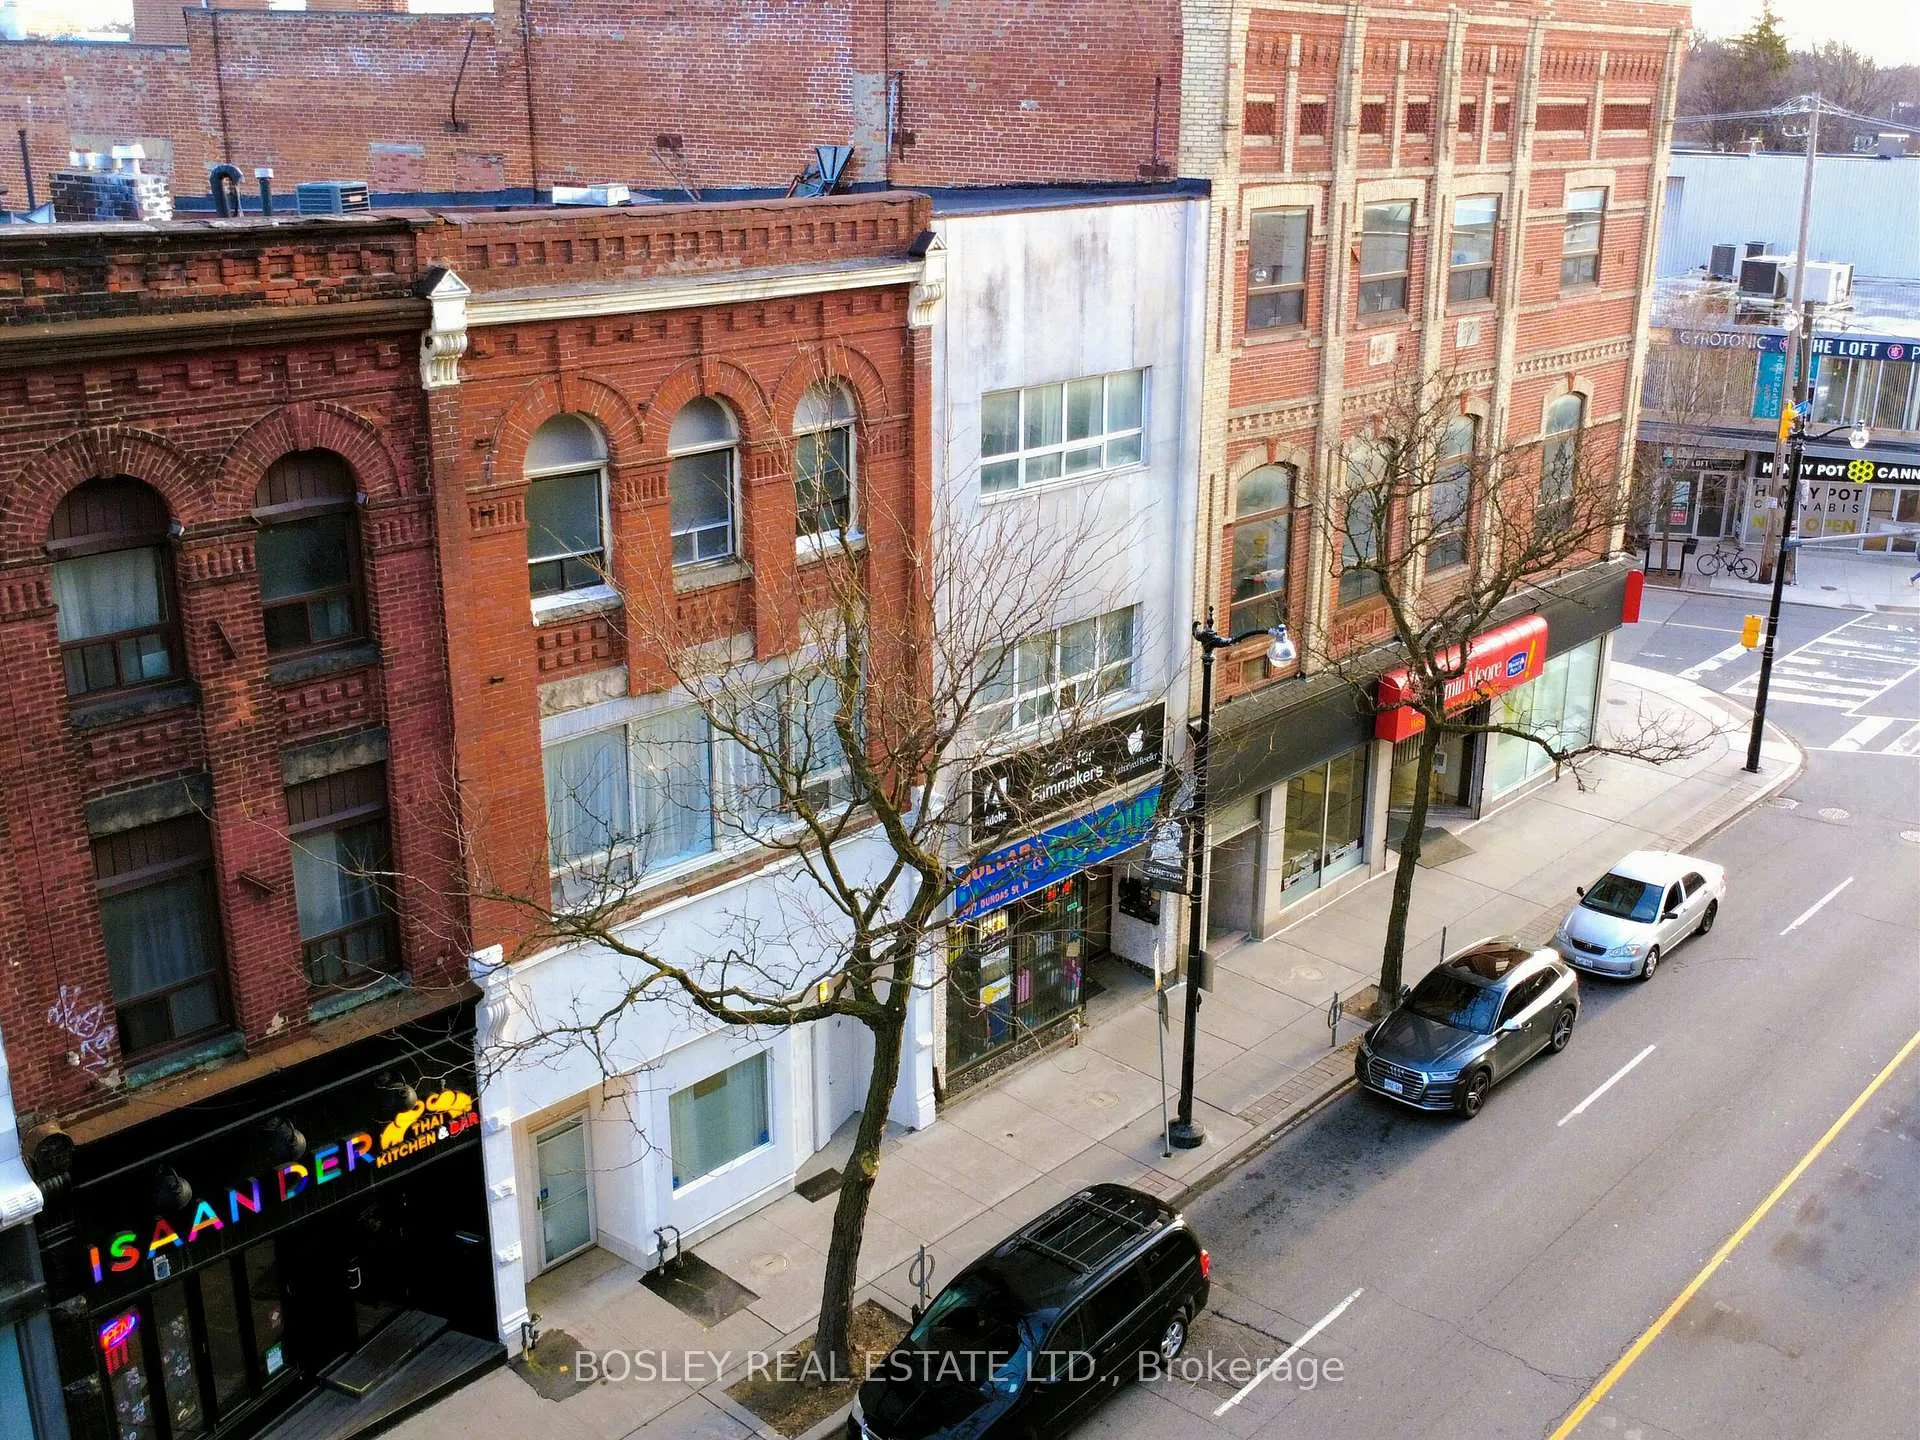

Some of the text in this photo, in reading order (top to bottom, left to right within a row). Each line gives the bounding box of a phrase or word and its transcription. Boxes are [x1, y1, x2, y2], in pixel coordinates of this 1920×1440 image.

[1813, 339, 1880, 357] HE LOFT
[1816, 464, 1846, 477] POT
[1828, 487, 1863, 501] POT
[1467, 661, 1503, 691] Moore
[1032, 765, 1104, 802] Filmmakers
[985, 810, 1008, 827] Adobe
[980, 889, 1010, 909] DUNDAS
[412, 1112, 444, 1136] THAI
[376, 1112, 480, 1168] KITCHEN & BAR
[88, 1131, 376, 1284] ISAAN DER
